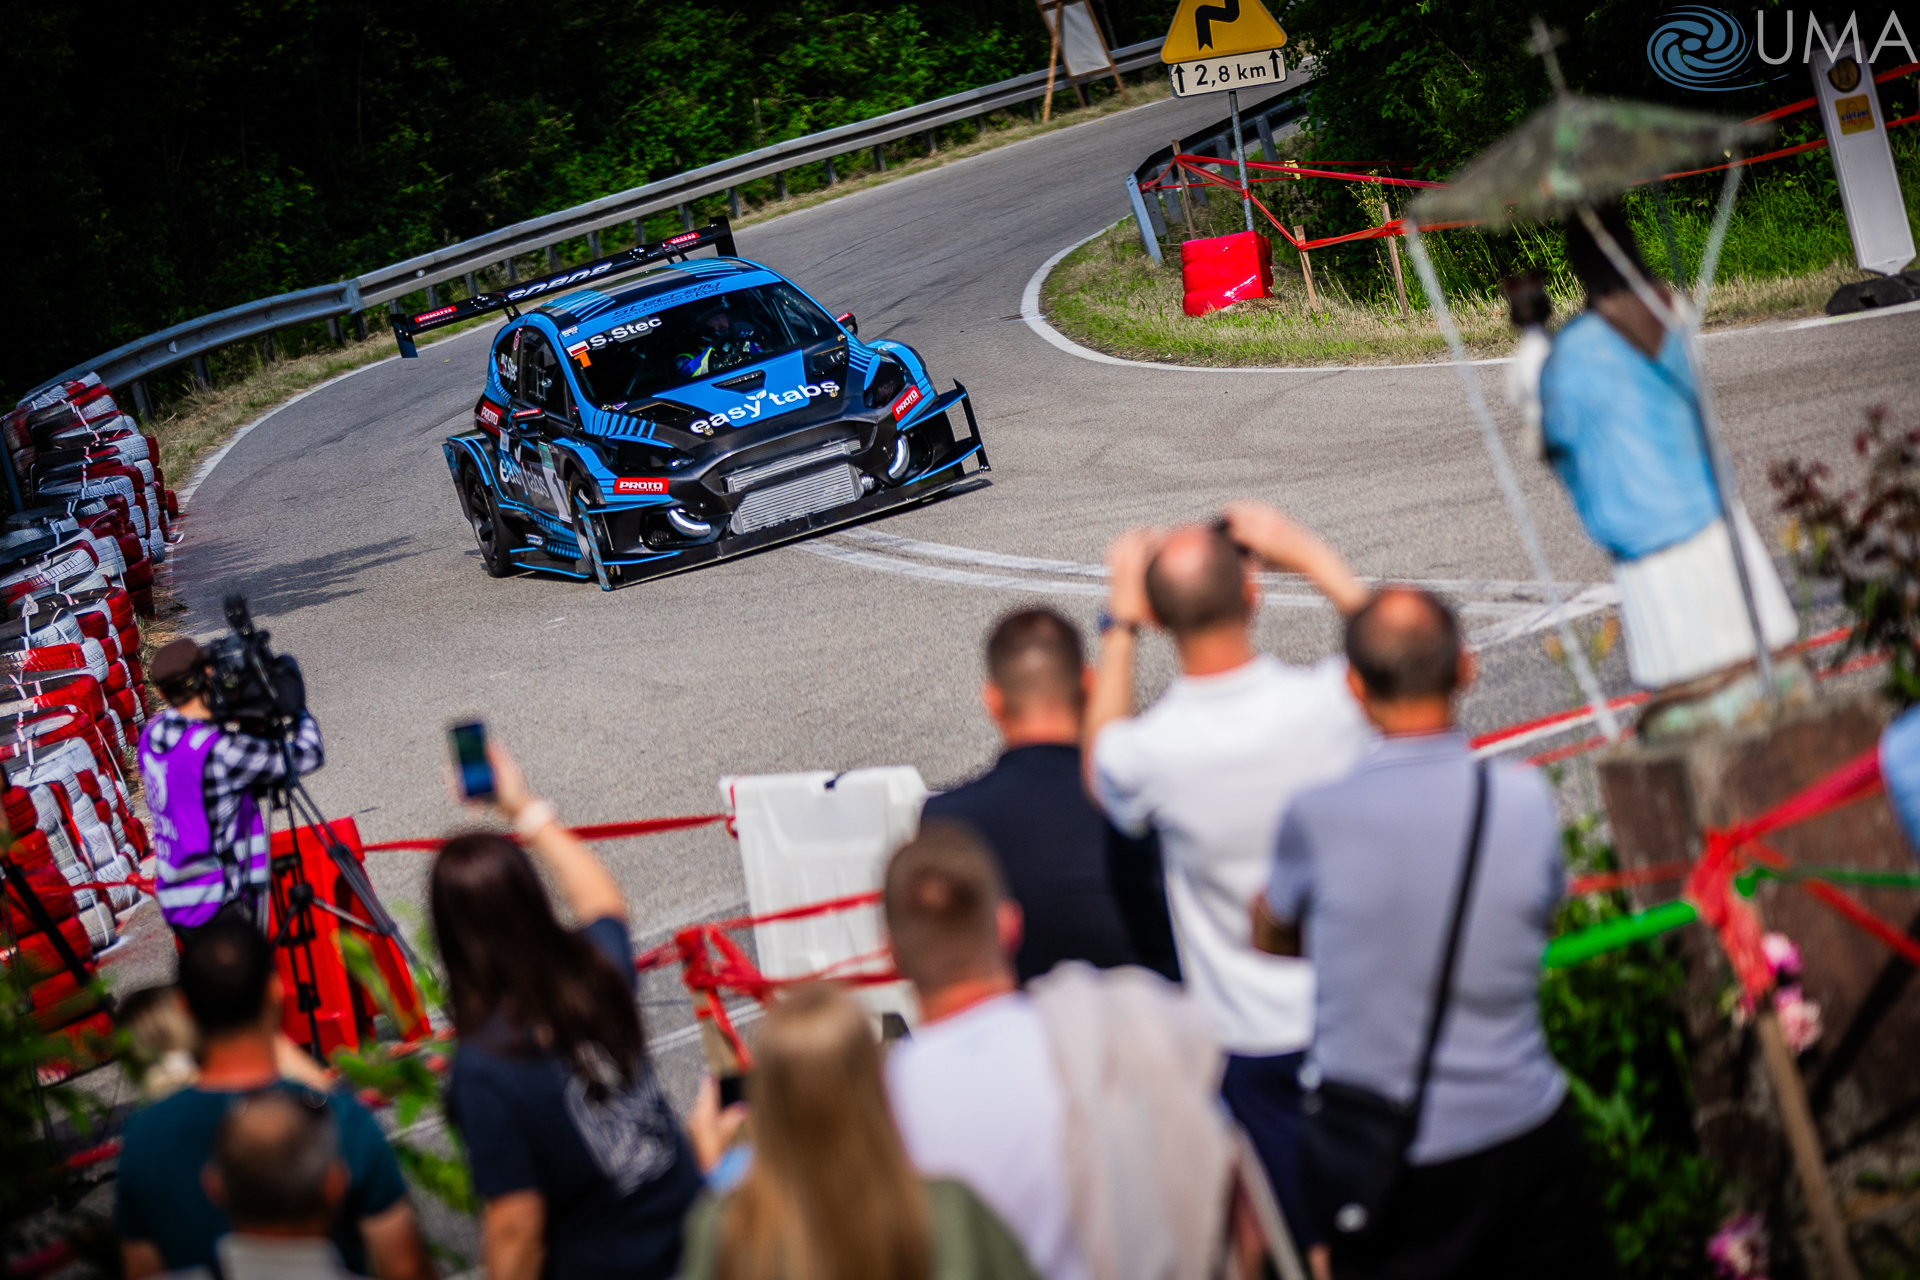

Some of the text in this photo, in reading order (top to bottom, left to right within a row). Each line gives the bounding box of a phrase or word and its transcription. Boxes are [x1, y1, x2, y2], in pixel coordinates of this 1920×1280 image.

[1194, 63, 1267, 88] 2,8 km
[589, 317, 662, 347] S.Stec
[573, 351, 592, 368] 1
[690, 380, 840, 434] easy tabs
[895, 389, 919, 415] PROTO
[481, 405, 499, 425] PROTO
[619, 481, 663, 489] PROTO
